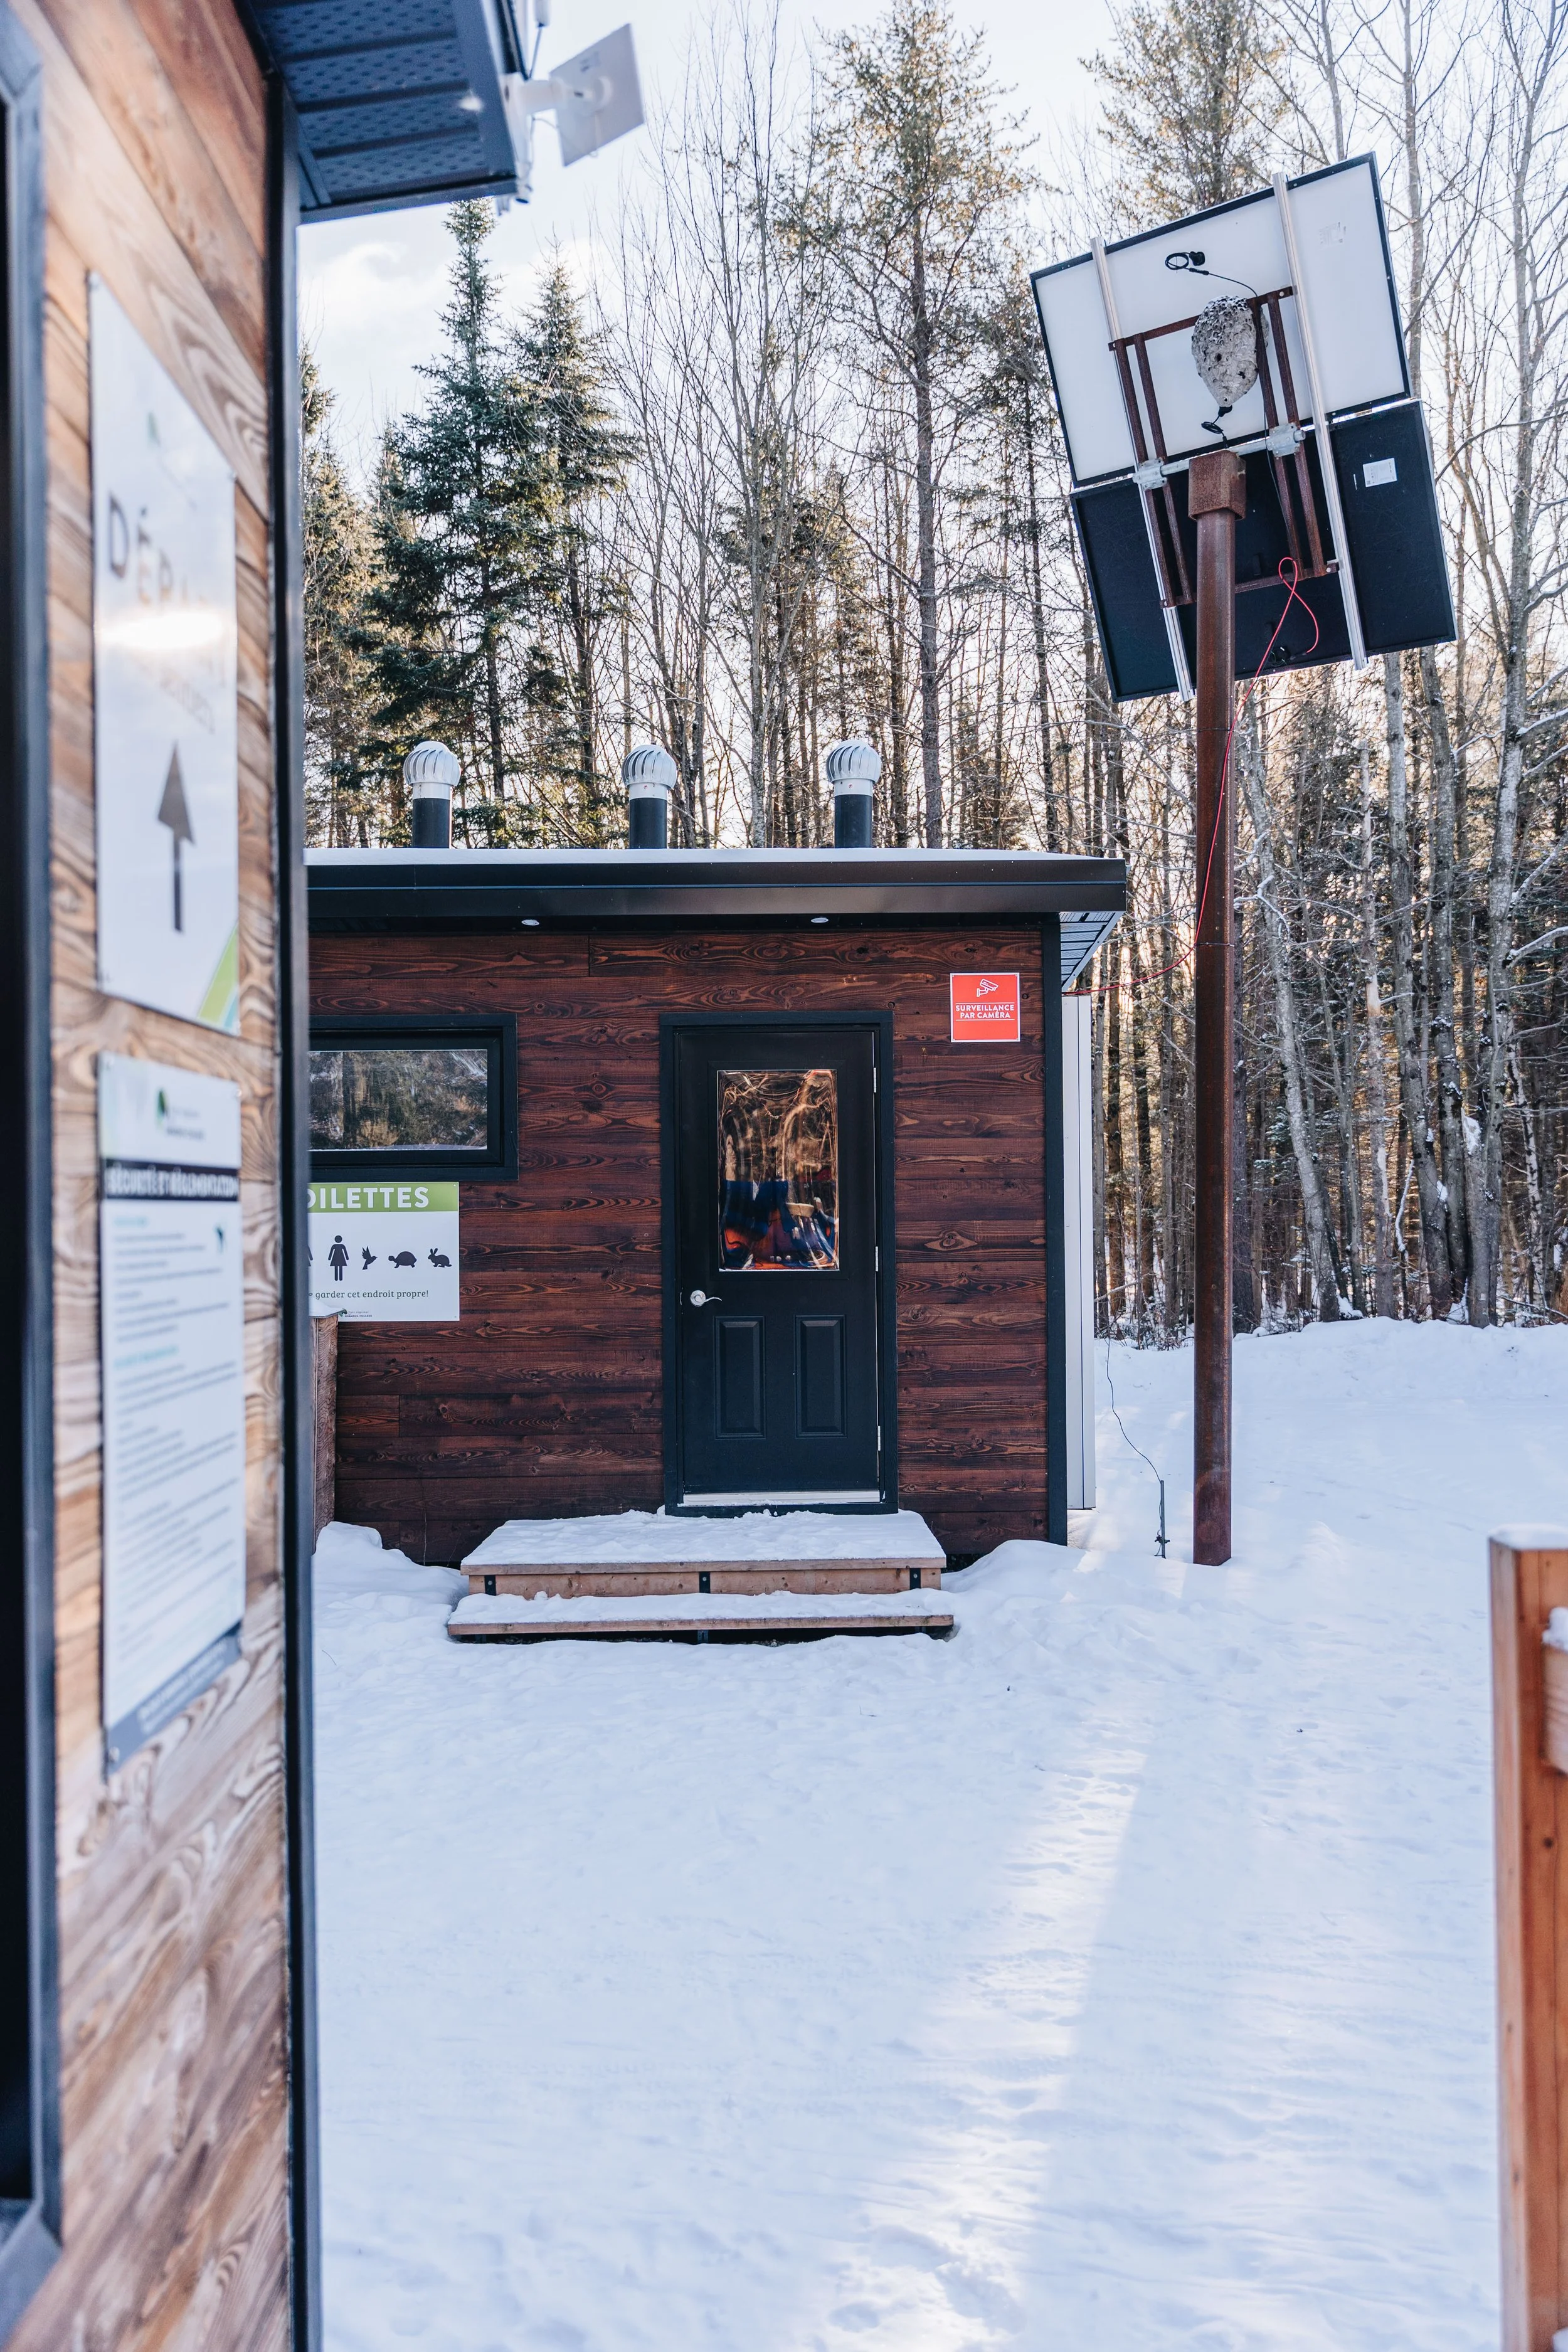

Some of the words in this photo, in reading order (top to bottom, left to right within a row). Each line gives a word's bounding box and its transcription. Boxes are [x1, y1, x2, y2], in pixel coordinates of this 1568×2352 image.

[977, 1010, 1010, 1019] CAMÉRA
[315, 1290, 345, 1300] garder
[363, 1290, 395, 1298] endroit
[396, 1290, 429, 1300] propre!
